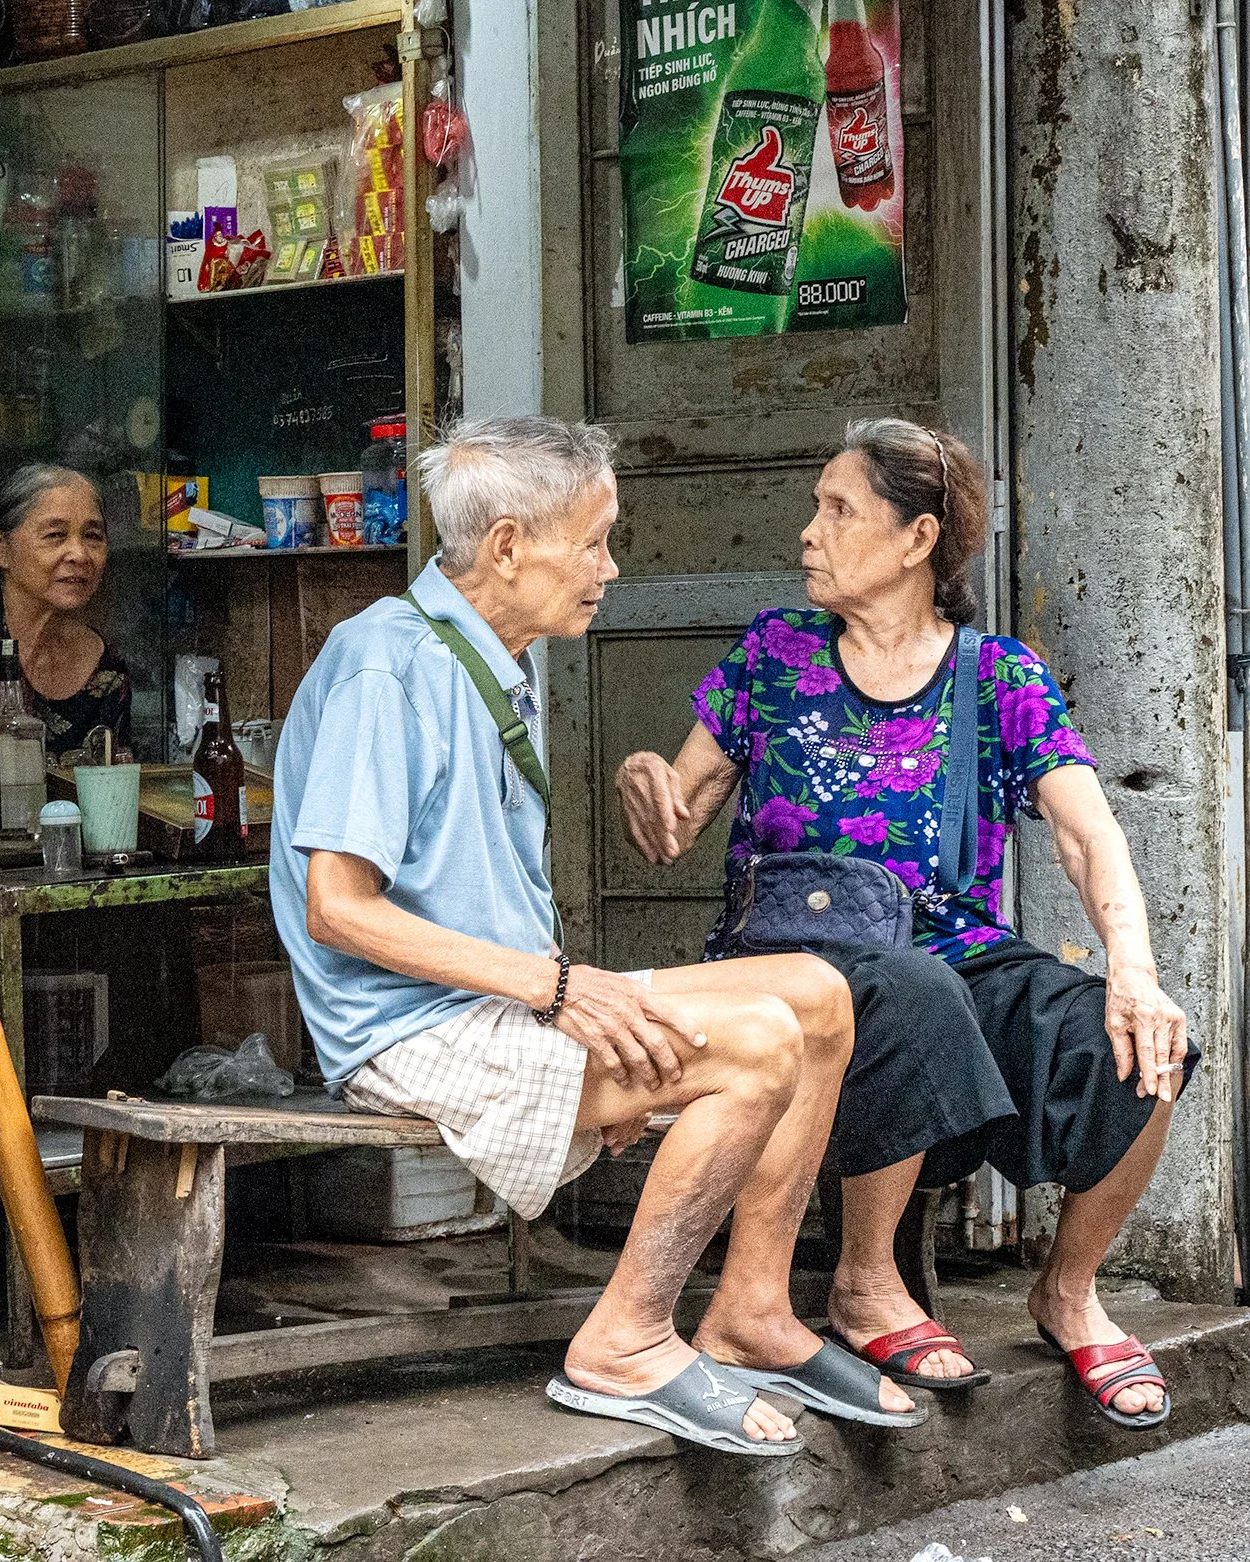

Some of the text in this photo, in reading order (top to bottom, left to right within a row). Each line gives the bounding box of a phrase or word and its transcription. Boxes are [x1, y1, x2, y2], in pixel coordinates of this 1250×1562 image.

[637, 2, 736, 59] NHÍCH
[639, 62, 663, 81] TIẾP
[665, 59, 690, 75] SINH
[639, 81, 669, 99] NGON
[672, 73, 700, 91] BÙNG
[729, 171, 790, 195] Thums
[725, 229, 791, 260] CHARGED
[747, 270, 768, 284] KIWI
[643, 312, 673, 322] CAFFEINE
[677, 309, 703, 320] VITAMIN
[704, 308, 713, 317] B3
[3, 1398, 49, 1411] vinataba
[707, 1400, 723, 1413] AIR
